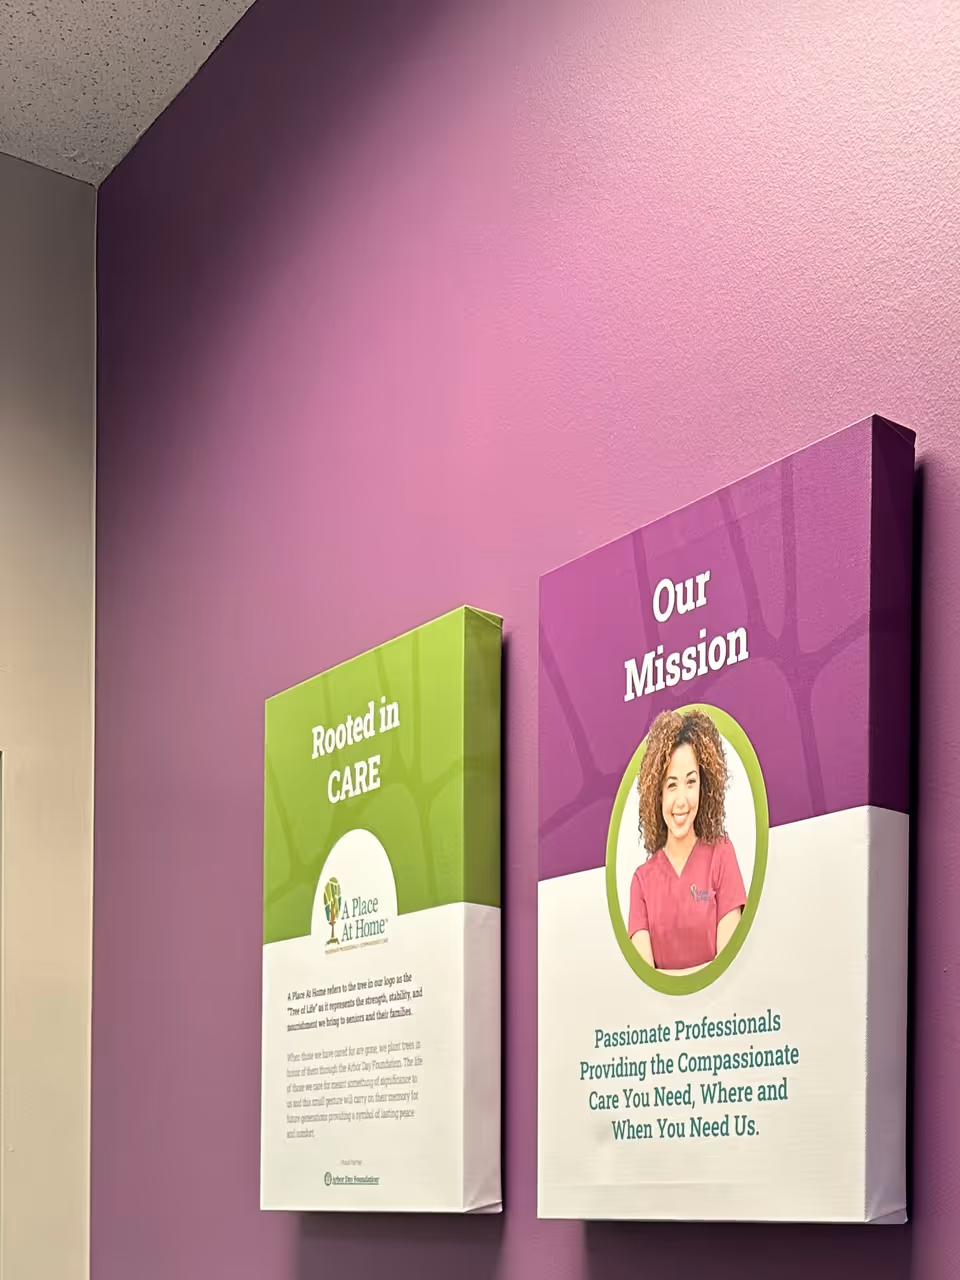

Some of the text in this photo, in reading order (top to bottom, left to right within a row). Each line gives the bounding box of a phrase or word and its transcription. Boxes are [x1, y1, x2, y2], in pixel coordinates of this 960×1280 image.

[652, 570, 710, 622] Our
[624, 627, 749, 702] Mission
[312, 696, 400, 759] Rooted in
[327, 754, 381, 803] CARE
[341, 896, 378, 920] A Place
[341, 918, 385, 941] At Home
[292, 991, 305, 1000] Place
[306, 990, 311, 998] At
[312, 988, 326, 997] Home
[327, 984, 341, 995] refers
[342, 984, 347, 992] to
[348, 981, 356, 991] the
[357, 981, 367, 990] tree
[368, 978, 373, 988] in
[374, 979, 383, 987] our
[384, 976, 395, 987] logo
[403, 972, 412, 982] the
[301, 1005, 305, 1014] of
[324, 1002, 328, 1011] it
[329, 1000, 355, 1012] represents
[356, 997, 364, 1006] the
[365, 993, 388, 1005] strength,
[389, 990, 411, 1001] stability,
[413, 987, 423, 998] and
[287, 1020, 317, 1032] nourishment
[326, 1017, 339, 1027] bring
[346, 1014, 364, 1023] seniors
[365, 1011, 375, 1021] and
[376, 1009, 388, 1019] their
[390, 1007, 413, 1018] families.
[594, 1009, 781, 1048] Passionate Professionals
[580, 1045, 799, 1081] Providing the Compassionate
[412, 1075, 417, 1083] to
[589, 1077, 789, 1110] Care You Need, Where and
[399, 1110, 415, 1120] peace
[611, 1114, 760, 1140] When You Need Us.
